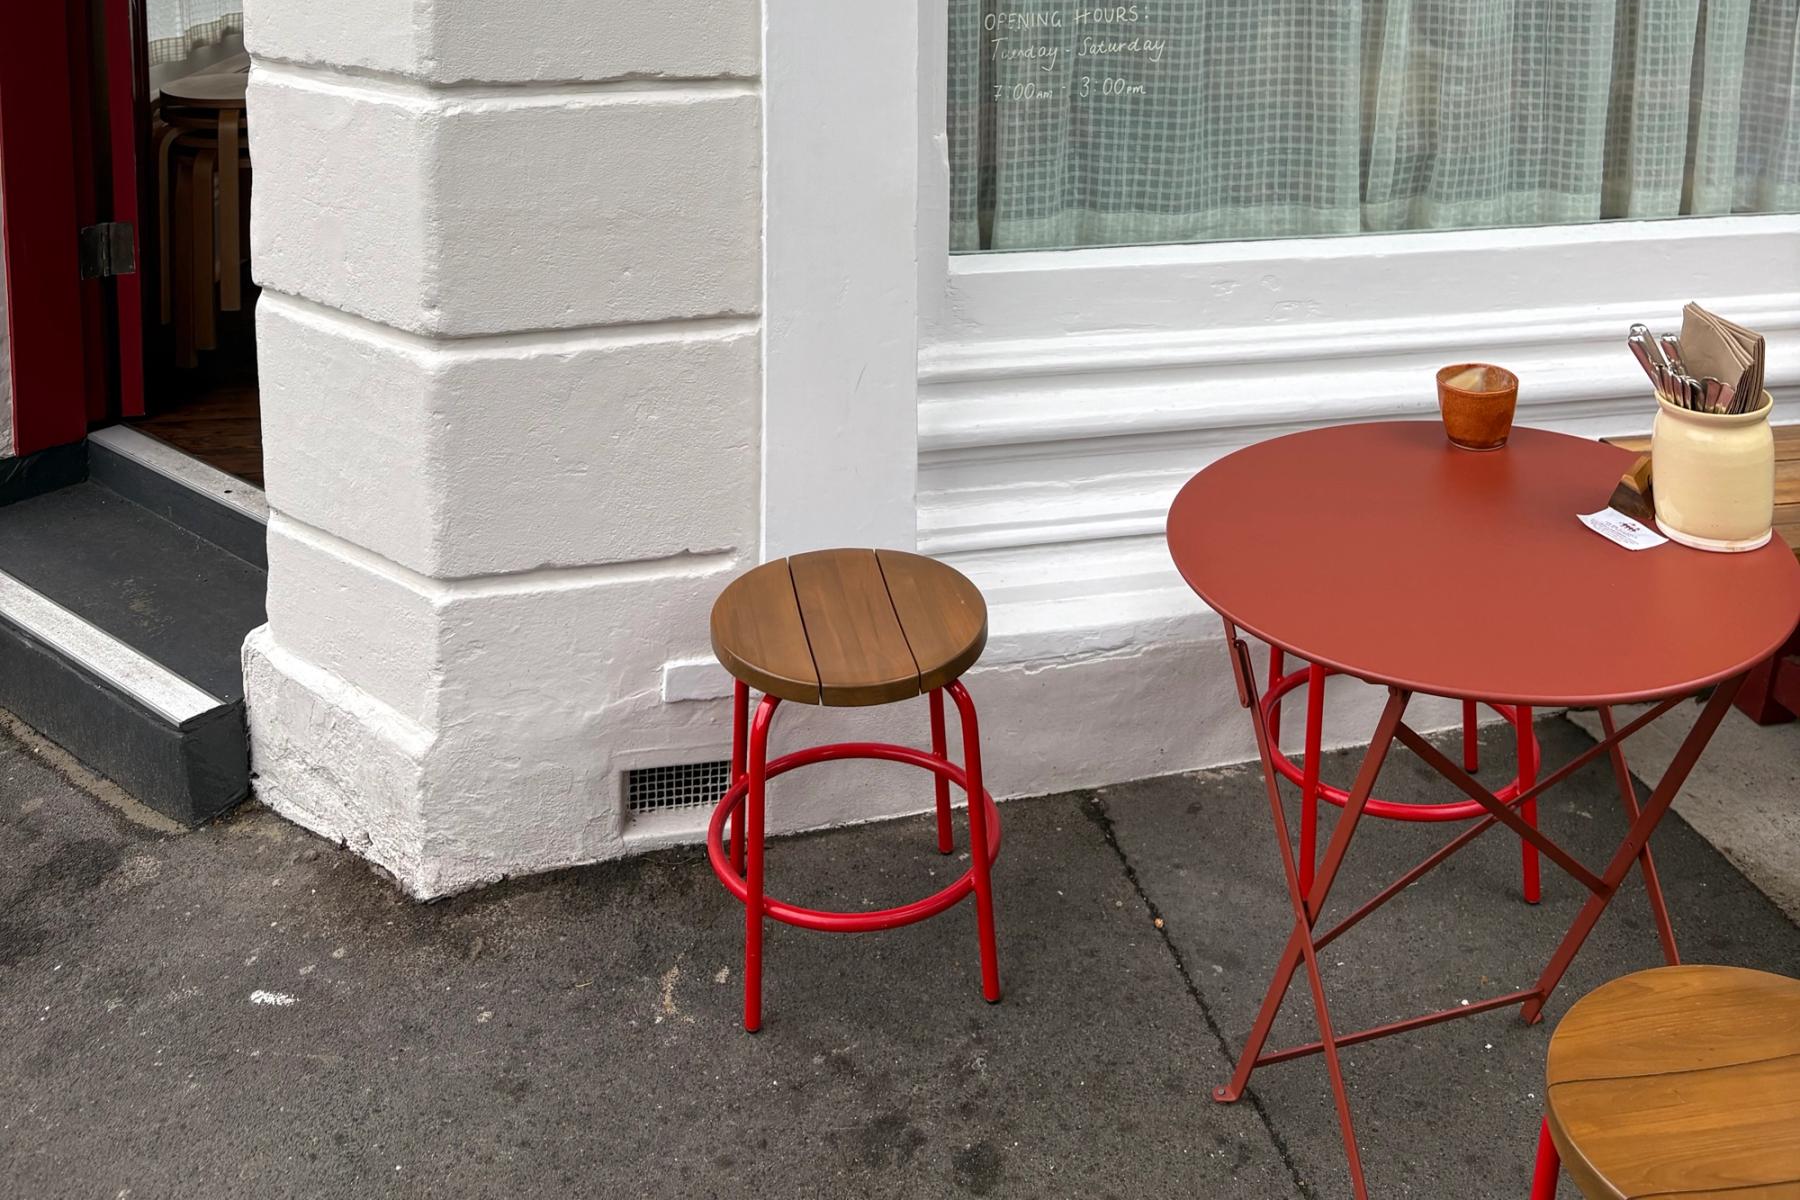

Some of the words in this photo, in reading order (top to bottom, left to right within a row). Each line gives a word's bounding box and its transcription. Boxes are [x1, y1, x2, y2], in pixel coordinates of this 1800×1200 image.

[984, 10, 1062, 31] OPENING
[1073, 5, 1149, 25] HOURS:
[1078, 36, 1166, 63] Saturday
